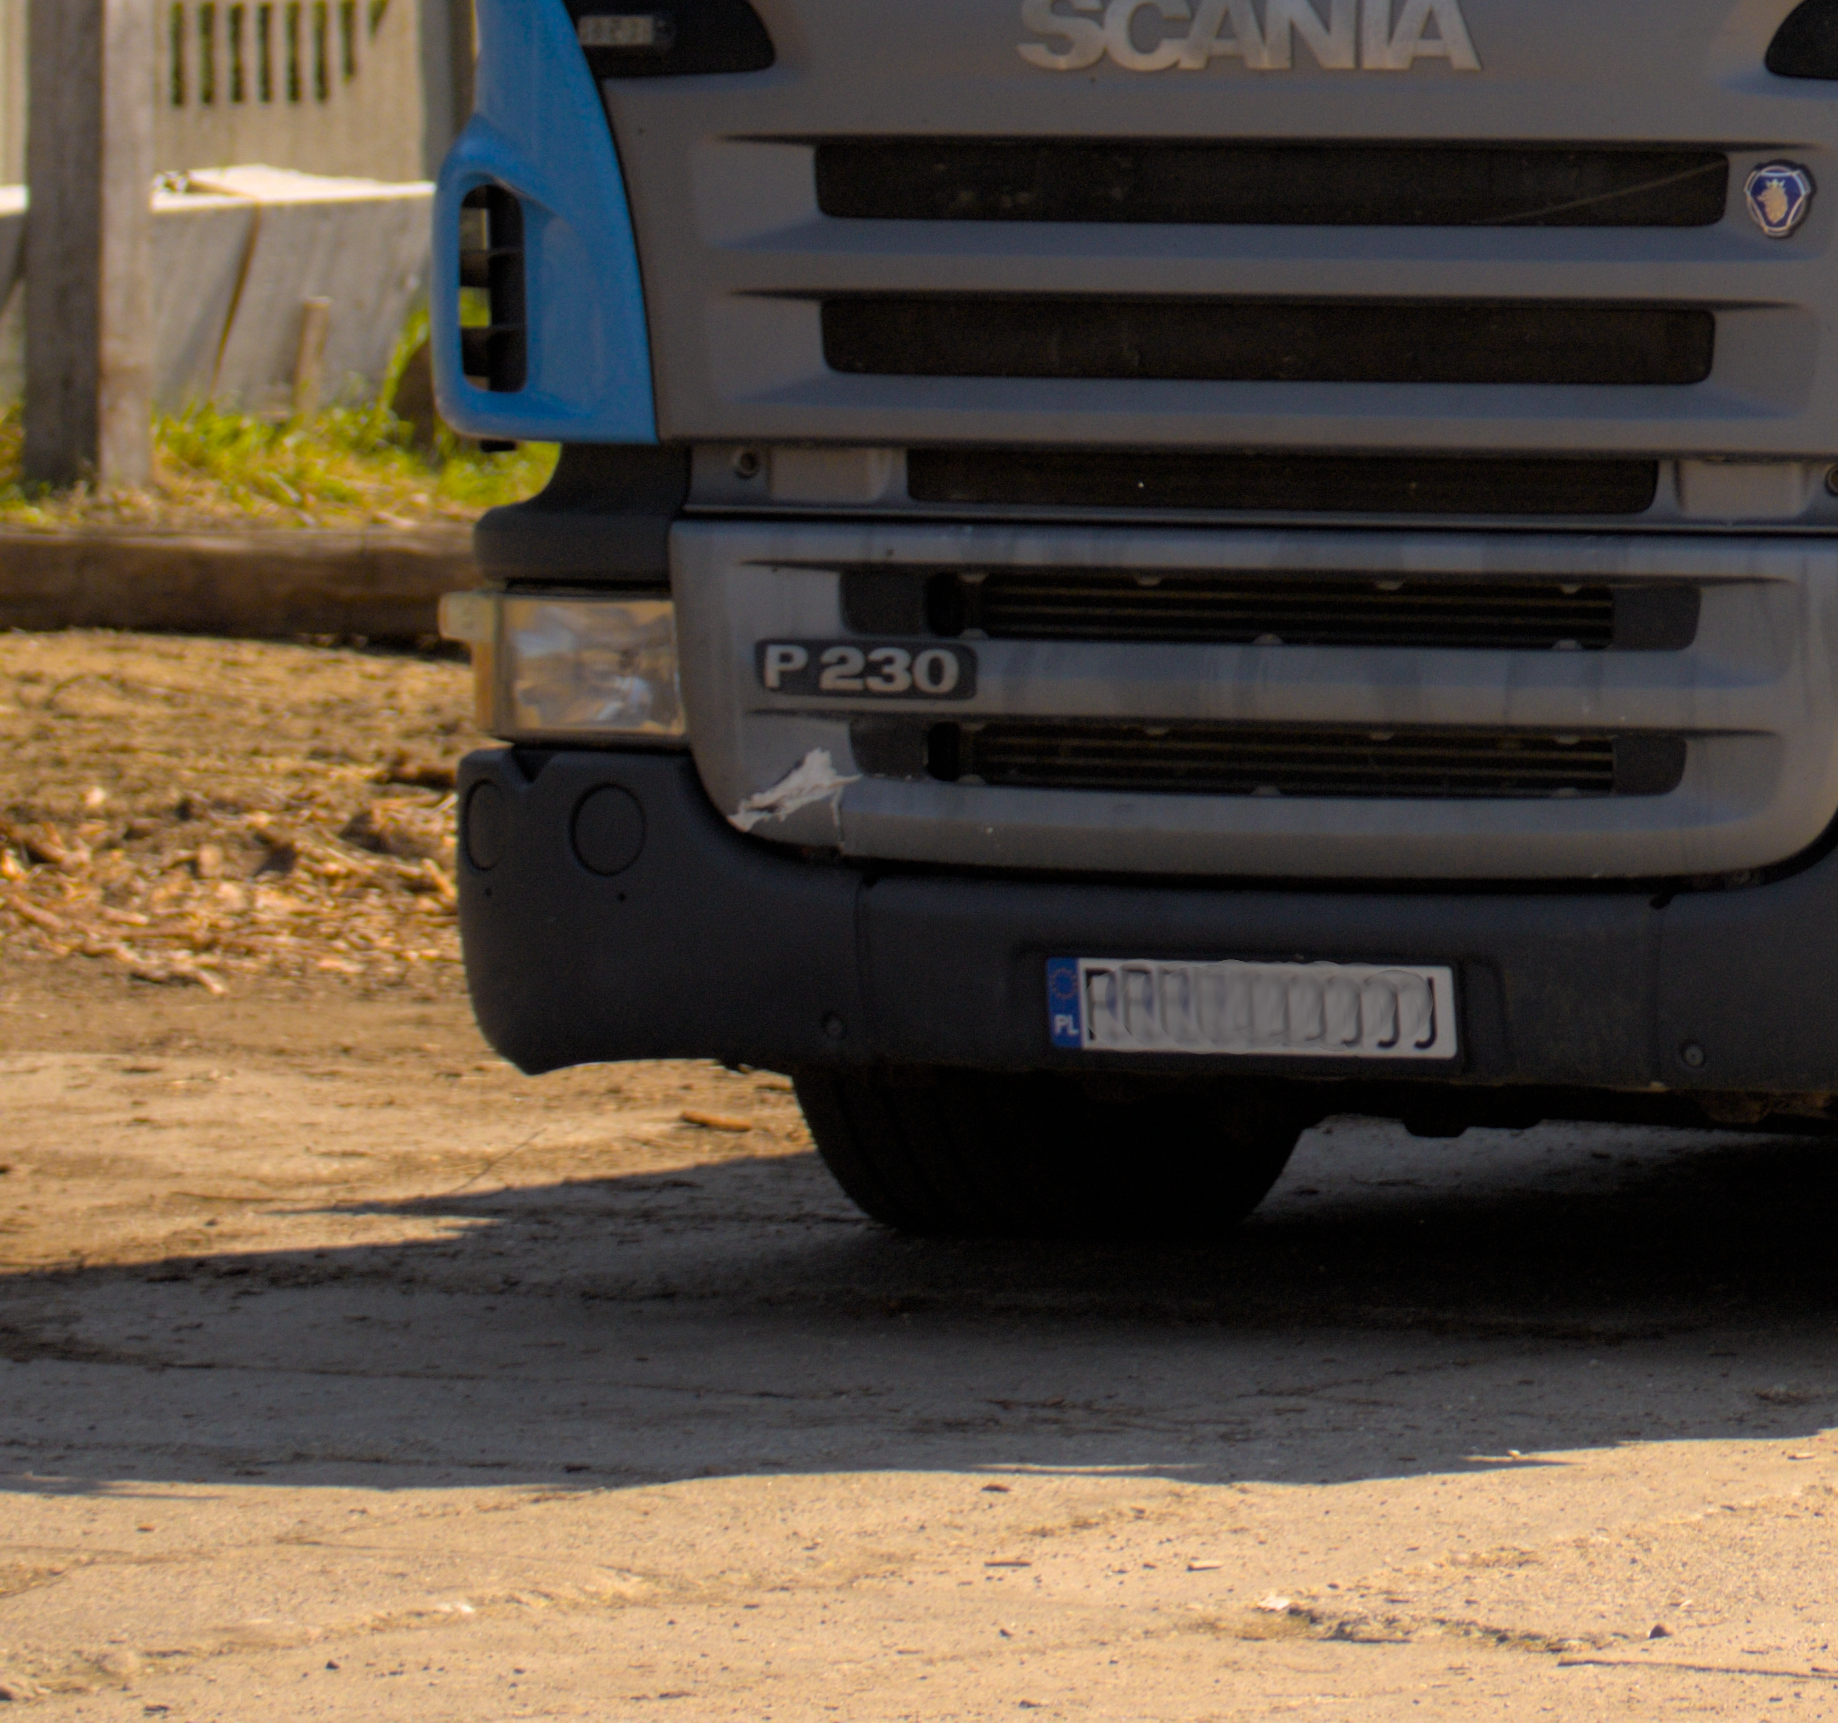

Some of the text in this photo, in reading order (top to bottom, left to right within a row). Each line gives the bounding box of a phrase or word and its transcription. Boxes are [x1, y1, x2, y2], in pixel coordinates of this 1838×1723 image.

[764, 644, 959, 694] P 230
[1053, 1014, 1079, 1036] PL
